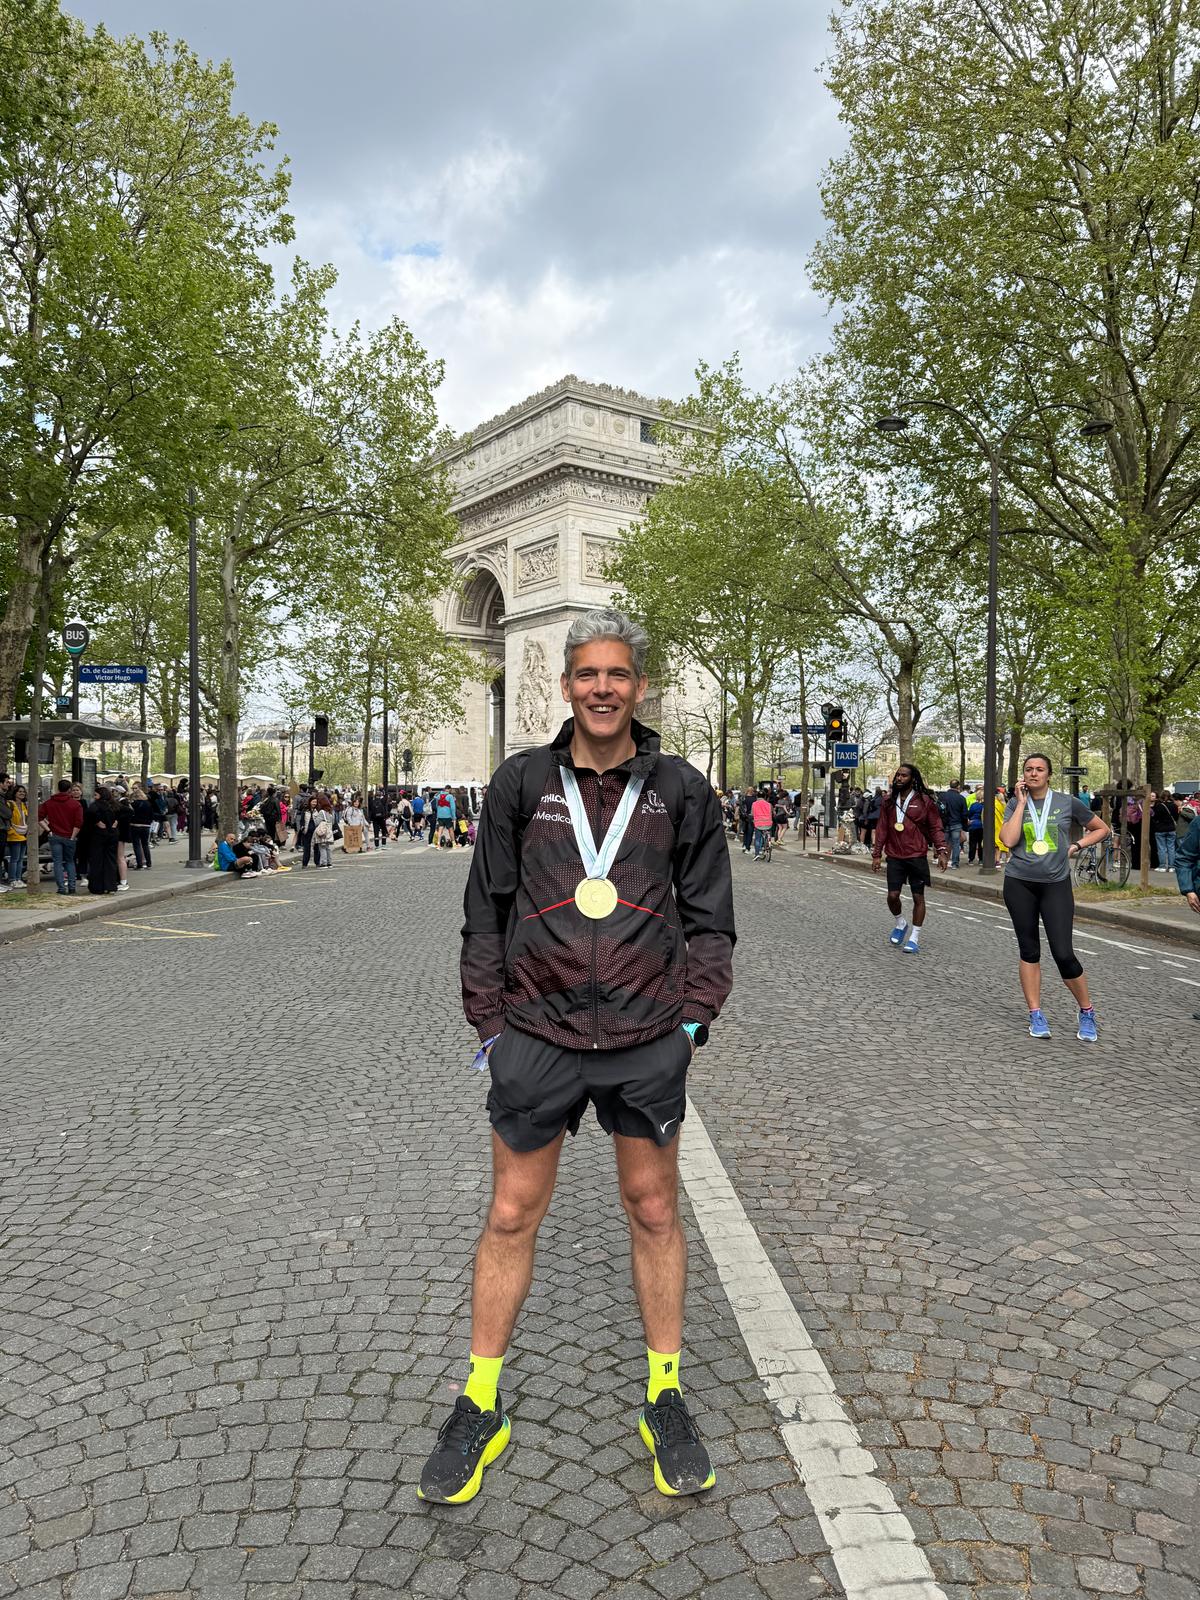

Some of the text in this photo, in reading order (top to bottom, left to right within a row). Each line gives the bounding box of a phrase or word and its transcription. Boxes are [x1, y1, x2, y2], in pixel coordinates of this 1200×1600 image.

[66, 630, 85, 640] BUS
[836, 751, 858, 760] TAXIS
[536, 811, 572, 824] Medica
